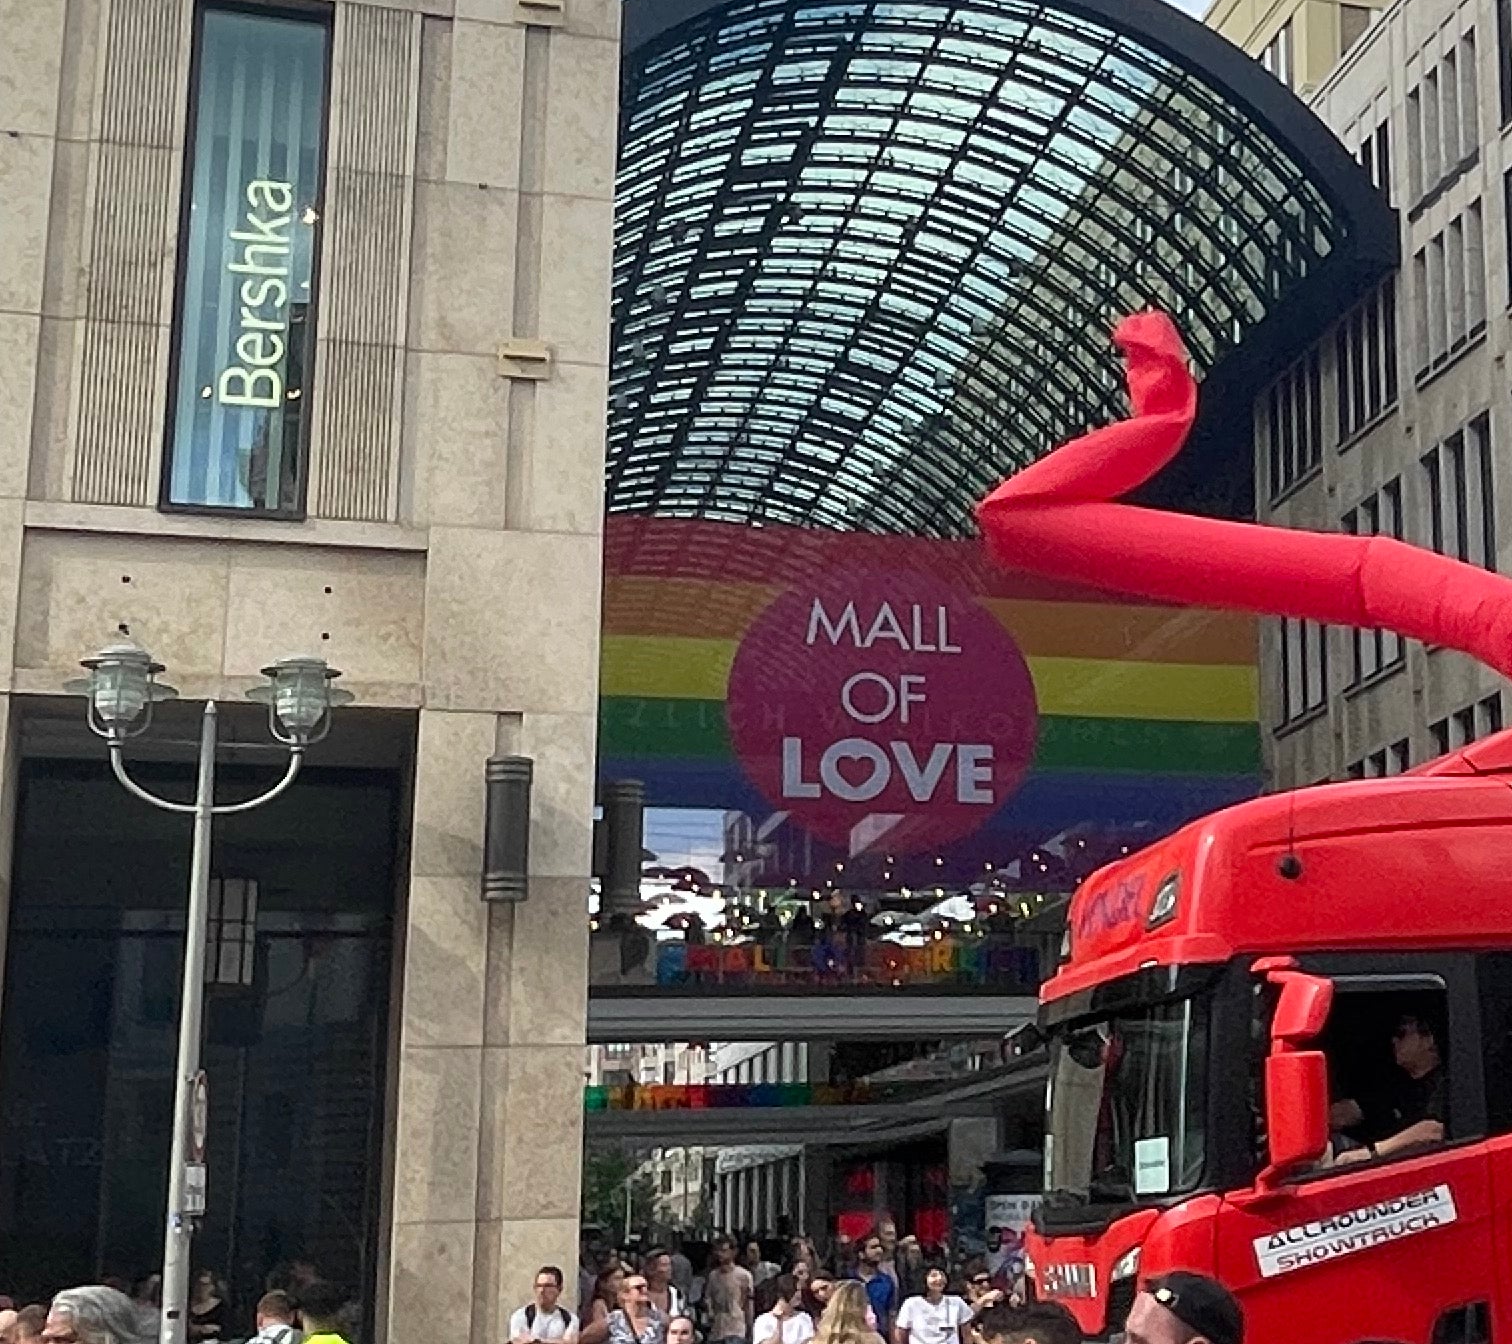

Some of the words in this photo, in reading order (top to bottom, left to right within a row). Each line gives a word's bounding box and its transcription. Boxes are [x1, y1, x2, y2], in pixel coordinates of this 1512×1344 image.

[218, 177, 292, 408] Bershka
[805, 597, 961, 655] MALL
[840, 671, 927, 725] OF
[782, 735, 994, 805] LOVE
[1268, 1189, 1440, 1251] ALLROUNDER
[1277, 1212, 1441, 1270] SHOWTRUCK
